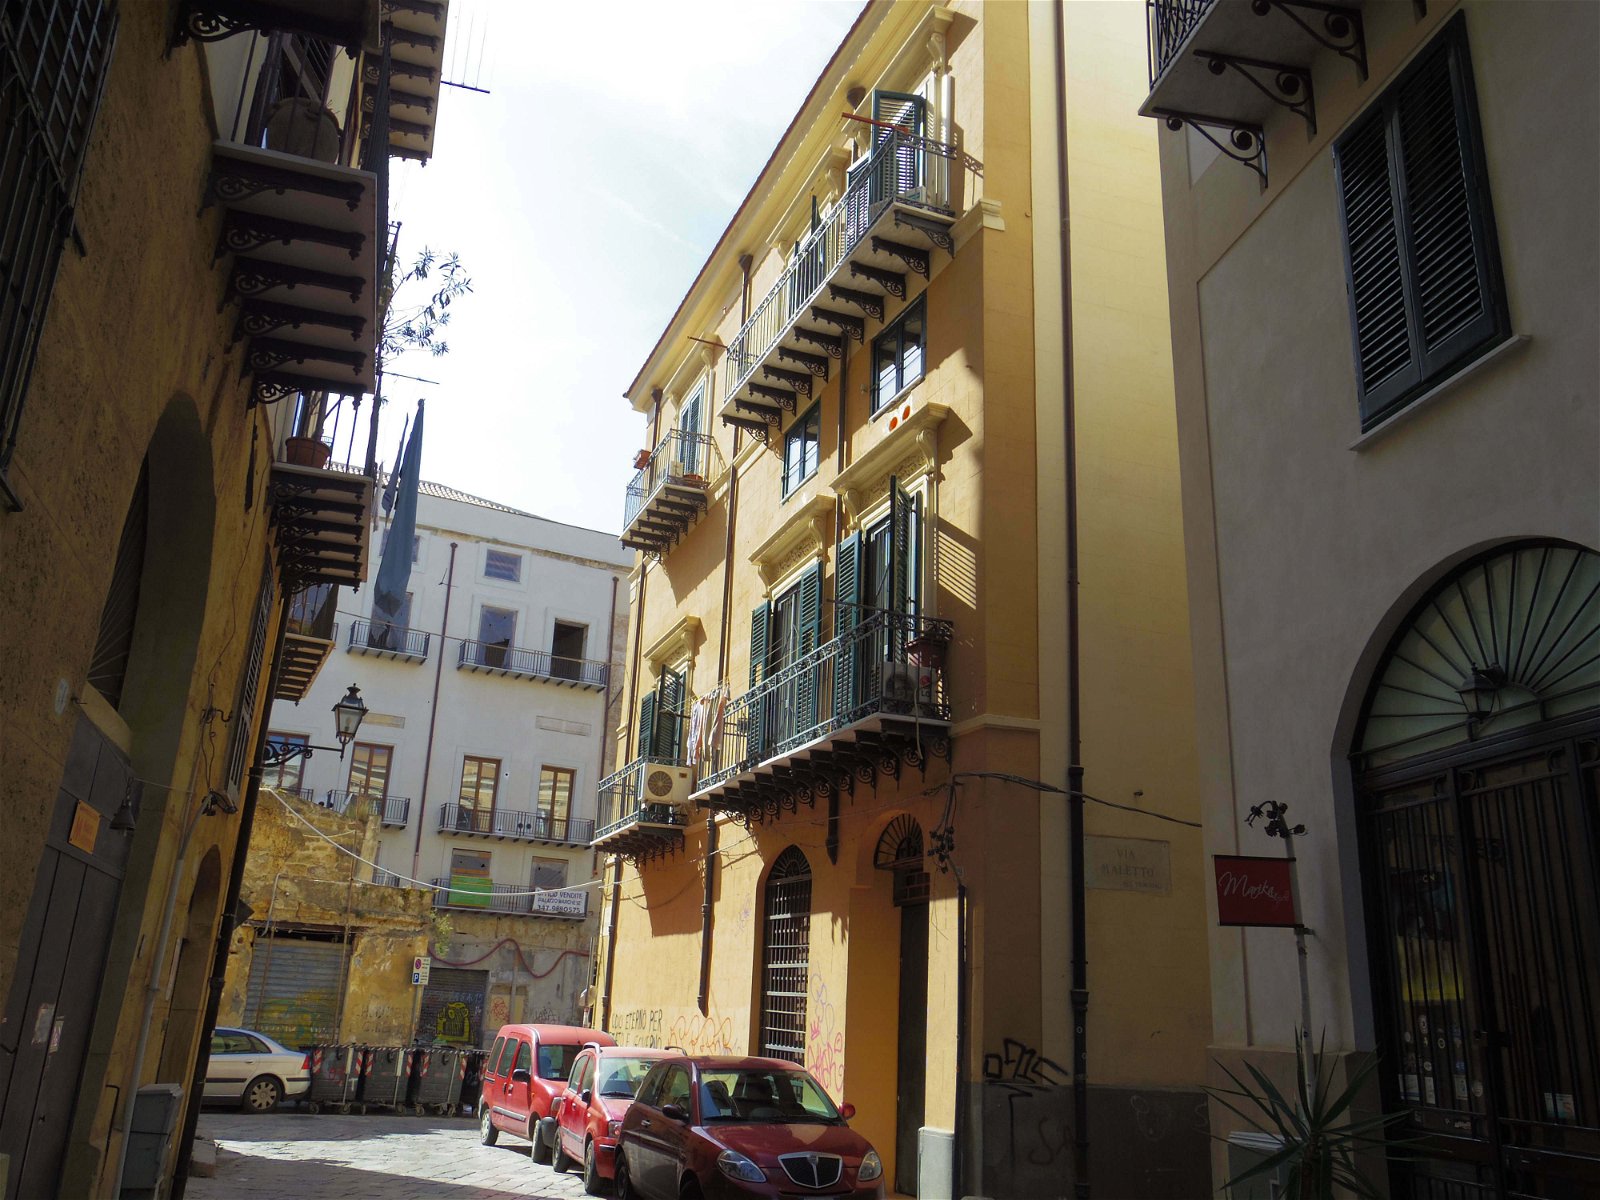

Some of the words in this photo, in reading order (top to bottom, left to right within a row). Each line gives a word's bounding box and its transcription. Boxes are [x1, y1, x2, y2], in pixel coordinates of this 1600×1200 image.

[1116, 848, 1136, 859] VIA
[1101, 863, 1155, 878] MALETTO
[559, 891, 583, 900] VENDITE
[649, 1008, 663, 1033] PER
